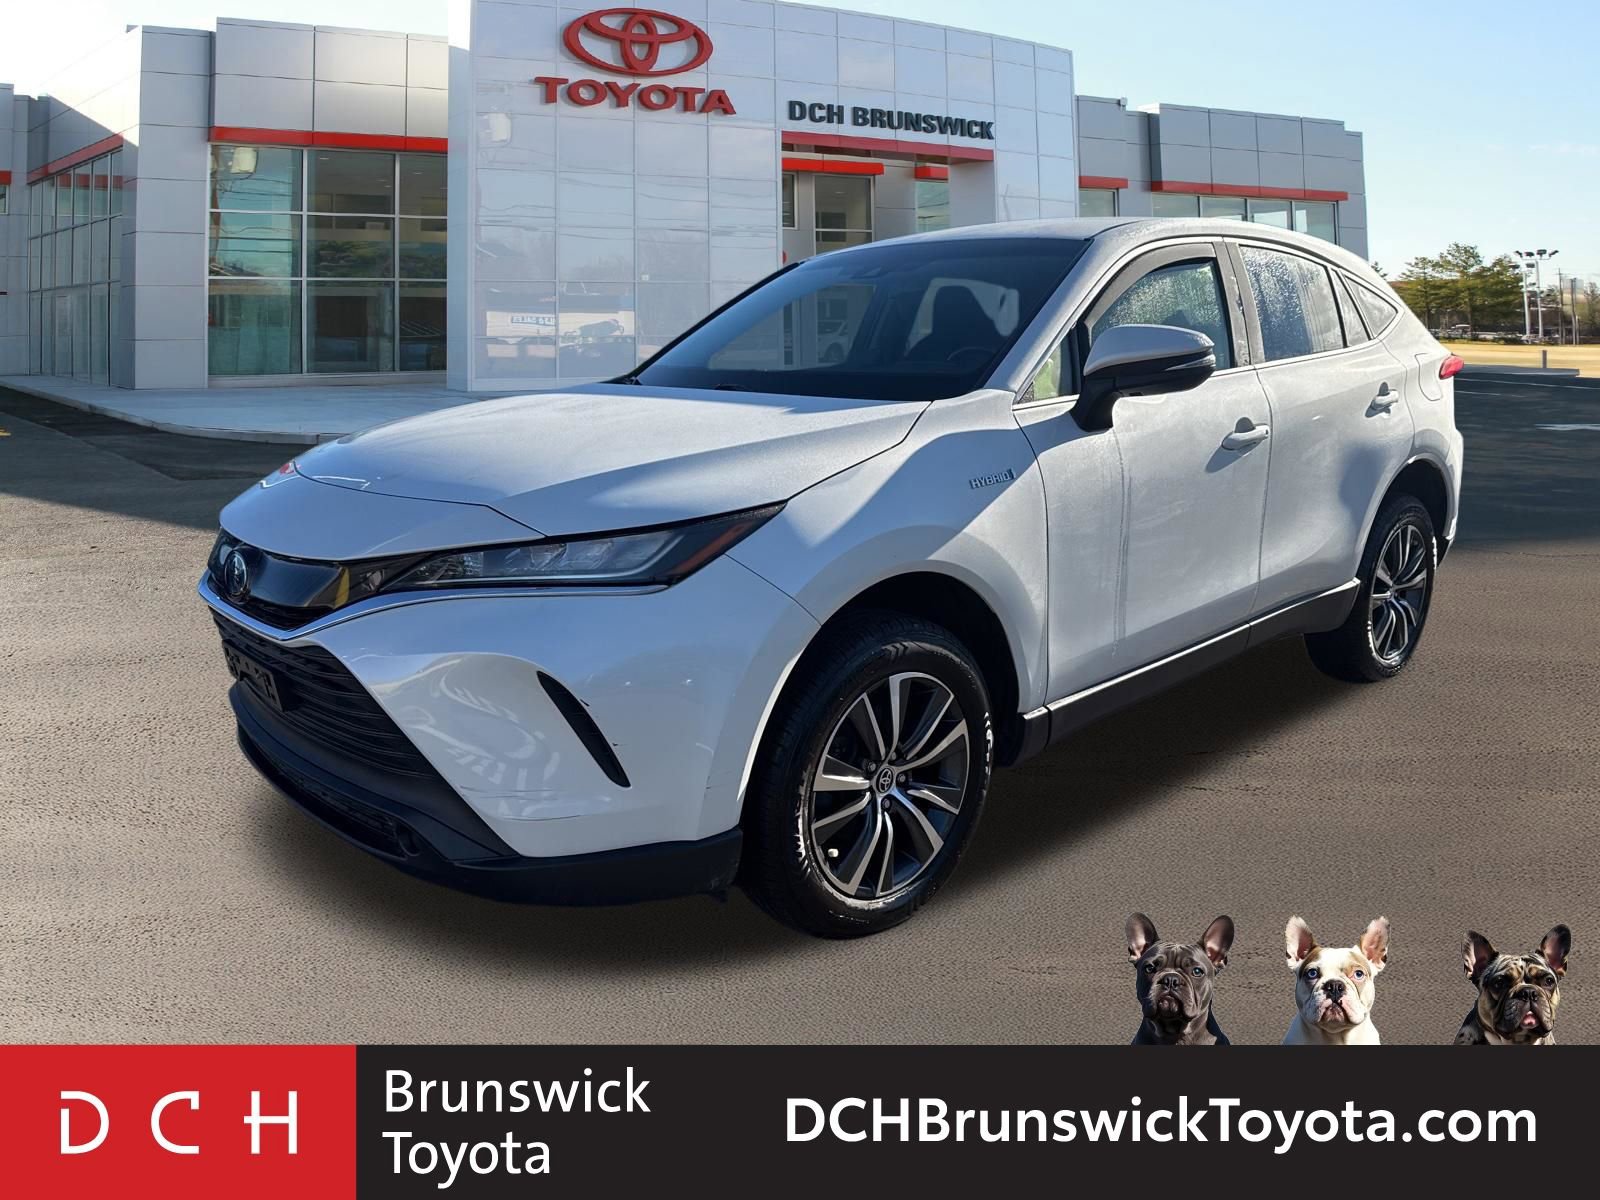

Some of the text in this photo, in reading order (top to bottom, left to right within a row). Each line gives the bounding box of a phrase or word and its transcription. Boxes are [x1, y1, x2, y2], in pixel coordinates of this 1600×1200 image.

[534, 76, 737, 115] TOYOTA
[788, 100, 995, 140] DCH BRUNSWICK
[969, 470, 1014, 489] HYBRID
